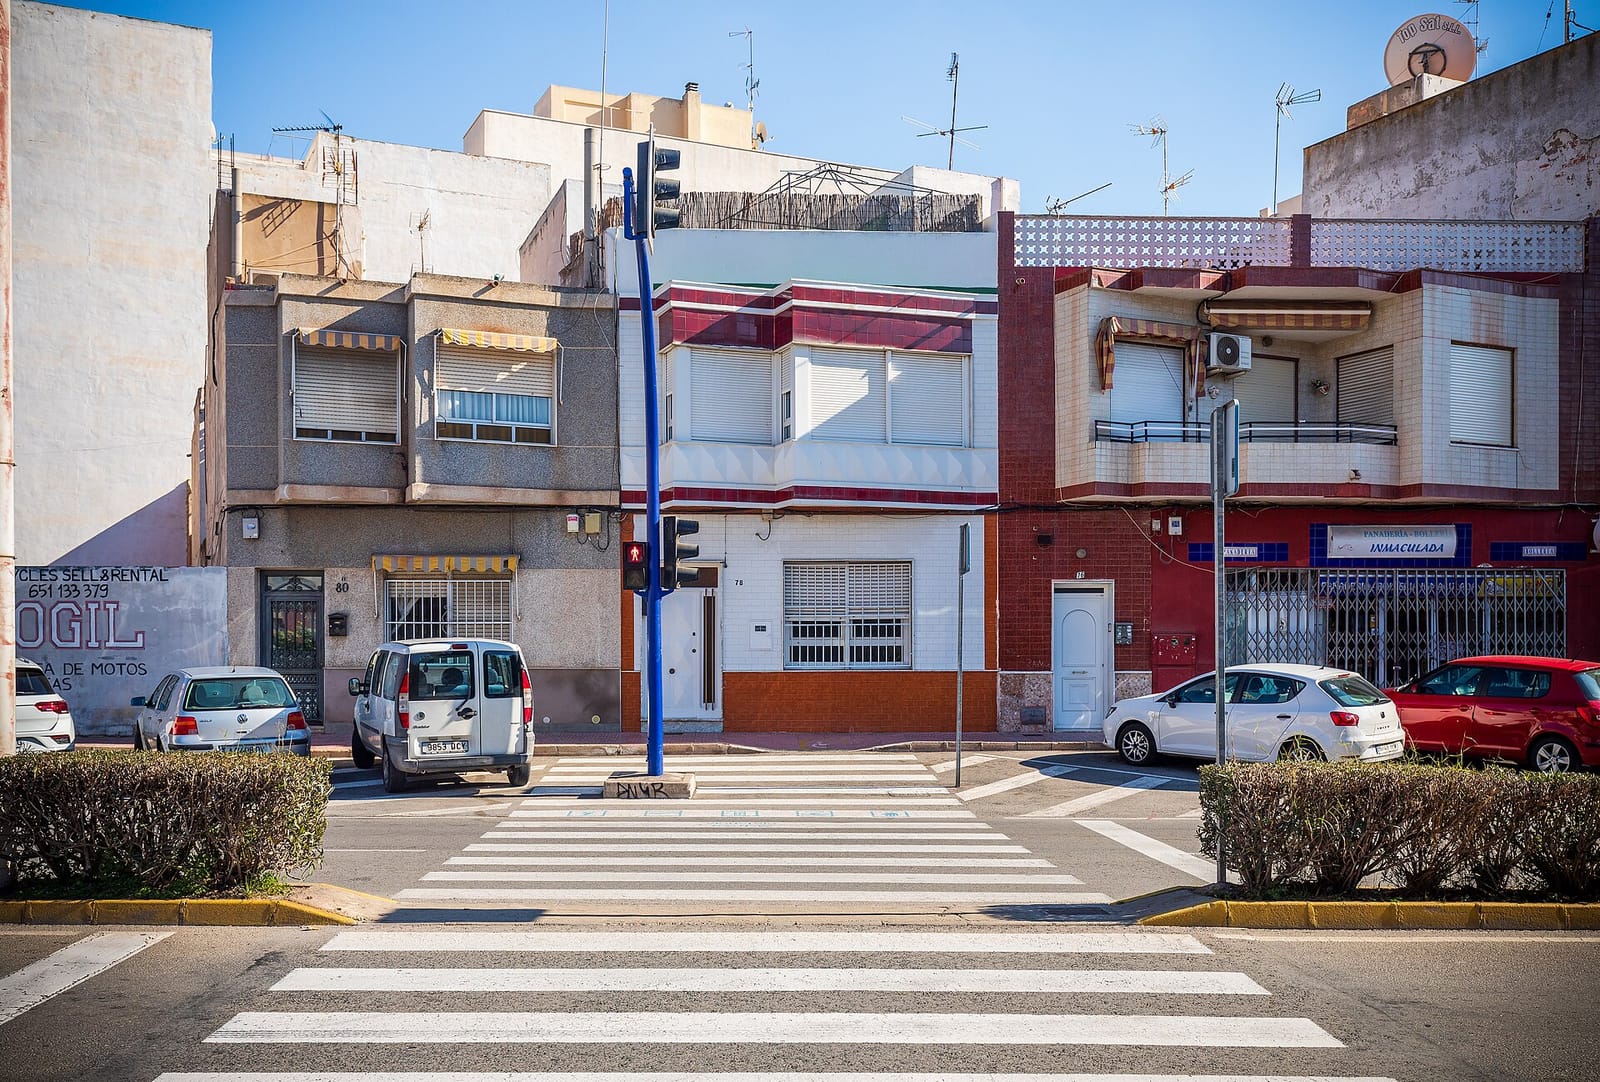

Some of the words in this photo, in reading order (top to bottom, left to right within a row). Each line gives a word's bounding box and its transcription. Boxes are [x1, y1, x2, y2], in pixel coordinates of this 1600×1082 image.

[1419, 15, 1441, 32] Sat
[1370, 543, 1444, 553] INMACULADA
[28, 583, 53, 599] 651
[57, 582, 81, 599] 133
[83, 583, 109, 599] 379
[335, 582, 349, 593] 80
[63, 663, 84, 676] DE
[91, 663, 148, 676] MOTOS
[427, 743, 448, 753] 9853
